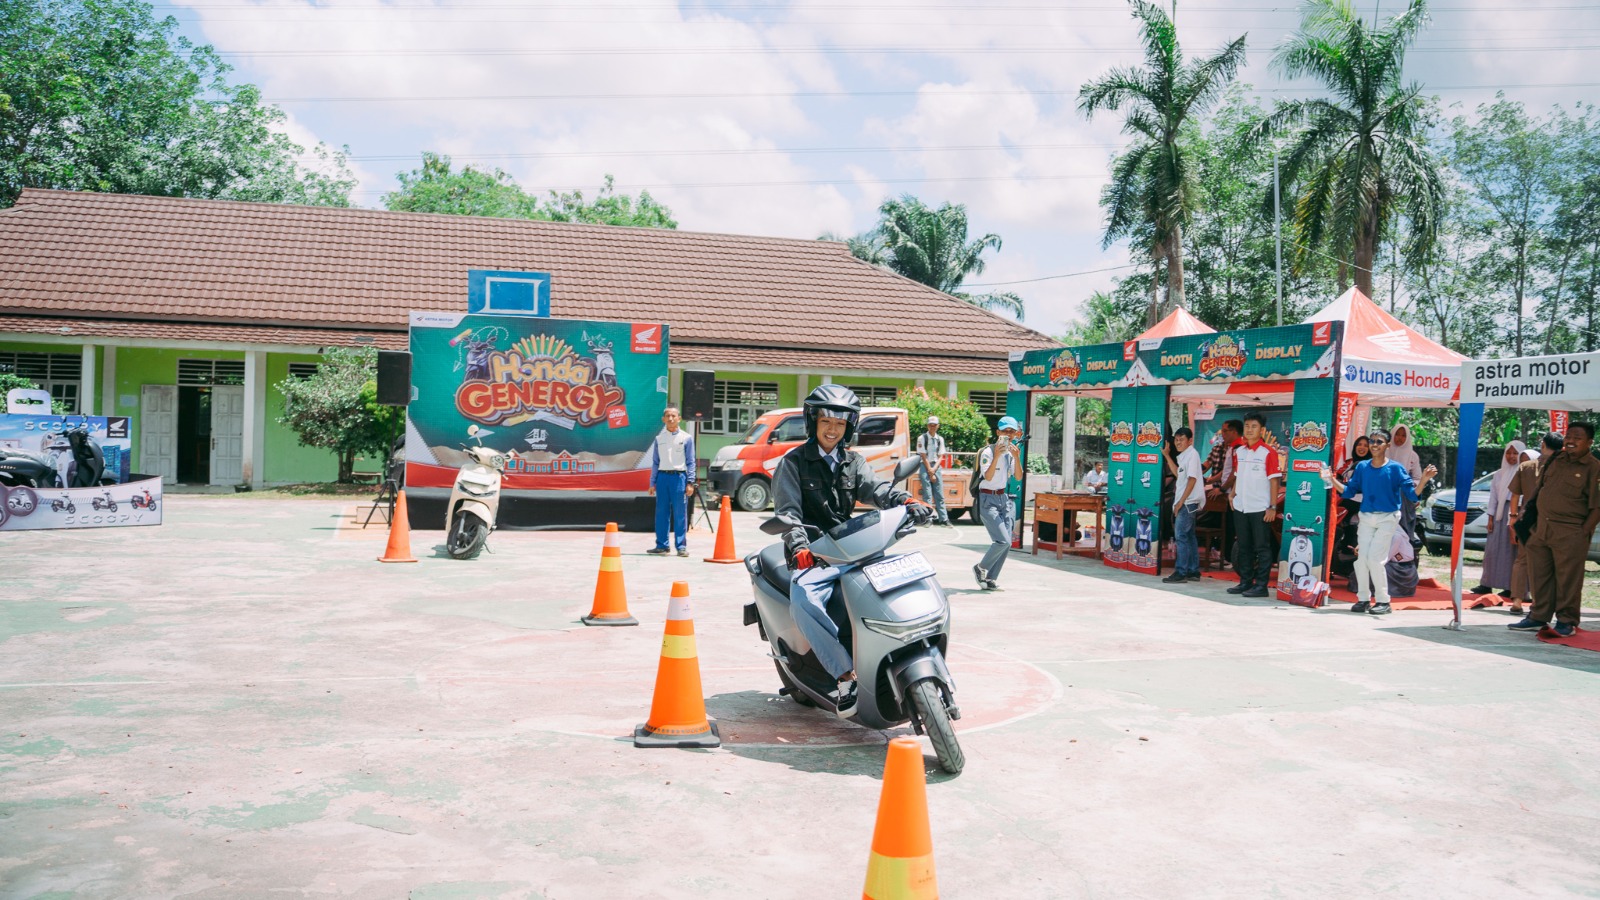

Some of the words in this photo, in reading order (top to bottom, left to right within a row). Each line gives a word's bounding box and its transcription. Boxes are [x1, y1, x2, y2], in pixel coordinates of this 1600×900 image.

[1160, 353, 1192, 367] BOOTH
[1255, 344, 1303, 360] DISPLAY
[1208, 343, 1238, 358] Honda
[491, 352, 591, 385] Honda
[1023, 365, 1045, 375] BOOTH
[1087, 359, 1118, 371] DISPLAY
[1199, 354, 1247, 373] GENERGY
[1475, 362, 1522, 380] astra
[1529, 358, 1591, 376] motor
[1049, 366, 1081, 381] GENERGY
[1359, 366, 1402, 385] tunas
[1404, 370, 1450, 389] Honda
[1475, 380, 1565, 398] Prabumulih
[459, 380, 622, 419] GENERGY
[24, 421, 102, 432] SCOOPY
[1292, 436, 1328, 450] GENERGY
[65, 513, 143, 525] SCOOPY
